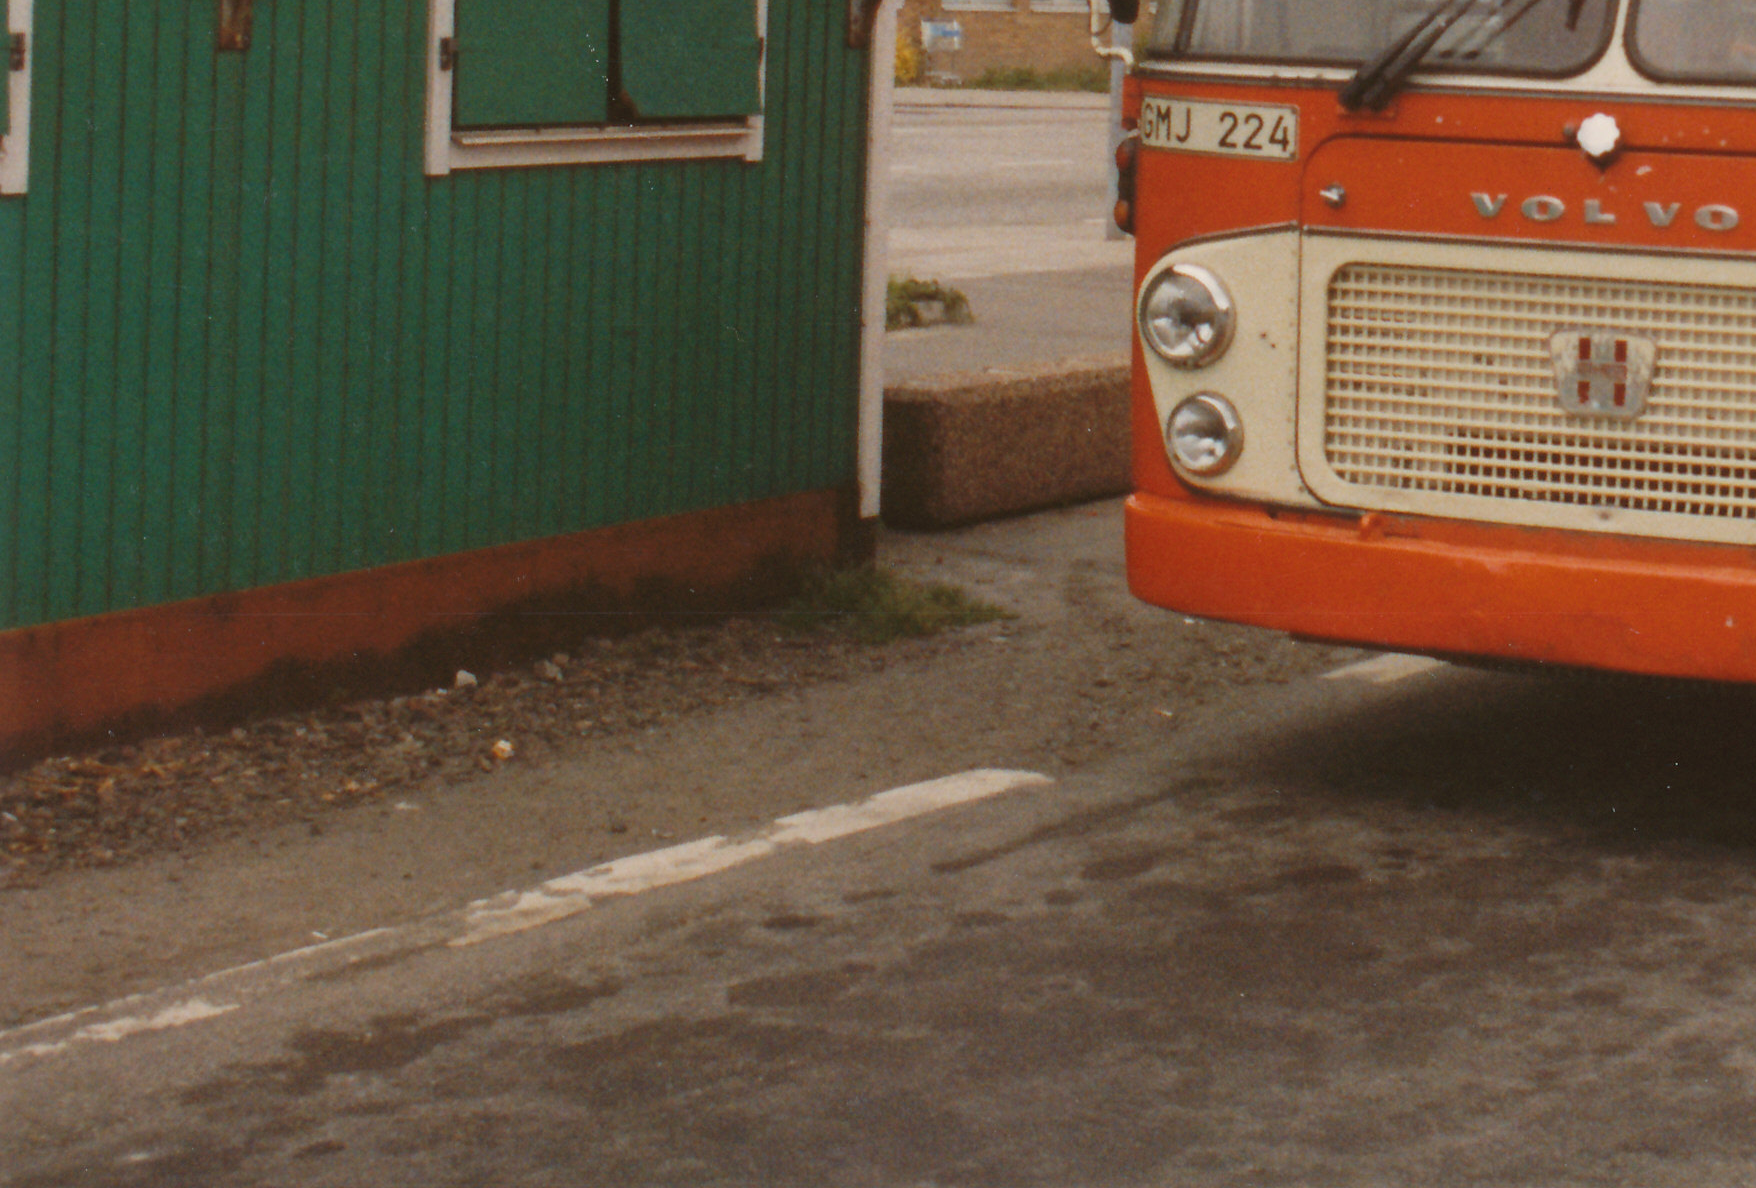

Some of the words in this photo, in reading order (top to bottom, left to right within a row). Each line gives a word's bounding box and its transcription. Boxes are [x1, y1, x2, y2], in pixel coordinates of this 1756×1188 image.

[1142, 103, 1191, 143] GMJ
[1218, 111, 1290, 153] 224
[1470, 191, 1740, 230] VOLVO
